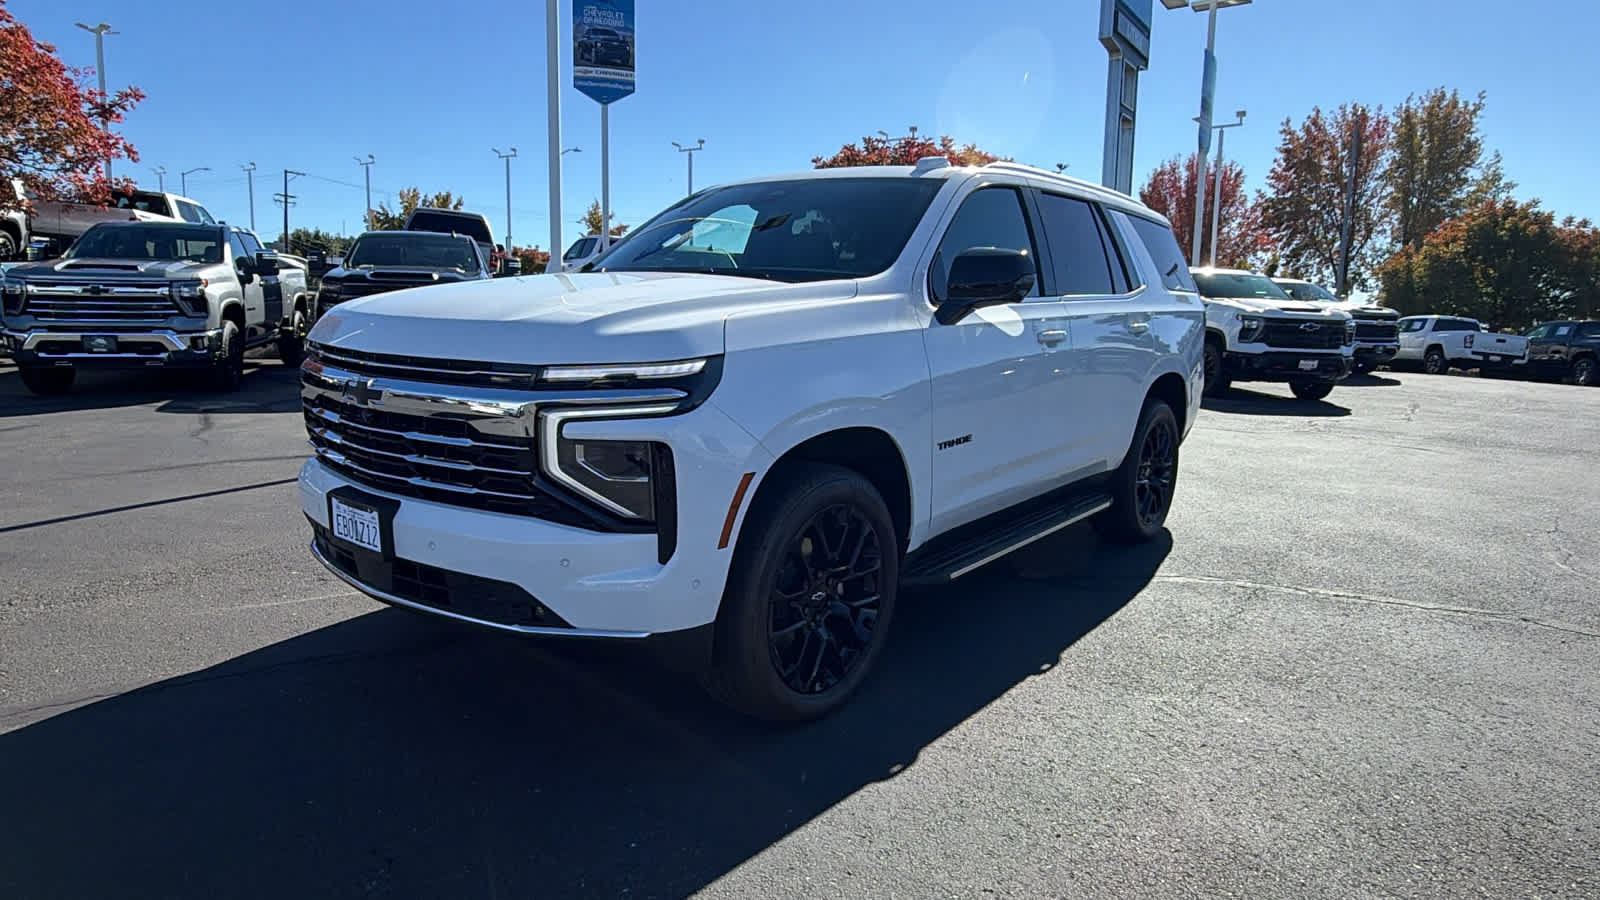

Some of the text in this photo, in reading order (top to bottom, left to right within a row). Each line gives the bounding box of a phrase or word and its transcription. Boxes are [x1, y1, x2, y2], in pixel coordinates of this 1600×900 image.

[583, 8, 624, 20] CHEVROLET
[594, 17, 625, 27] REDDING
[937, 433, 973, 451] TAHOE
